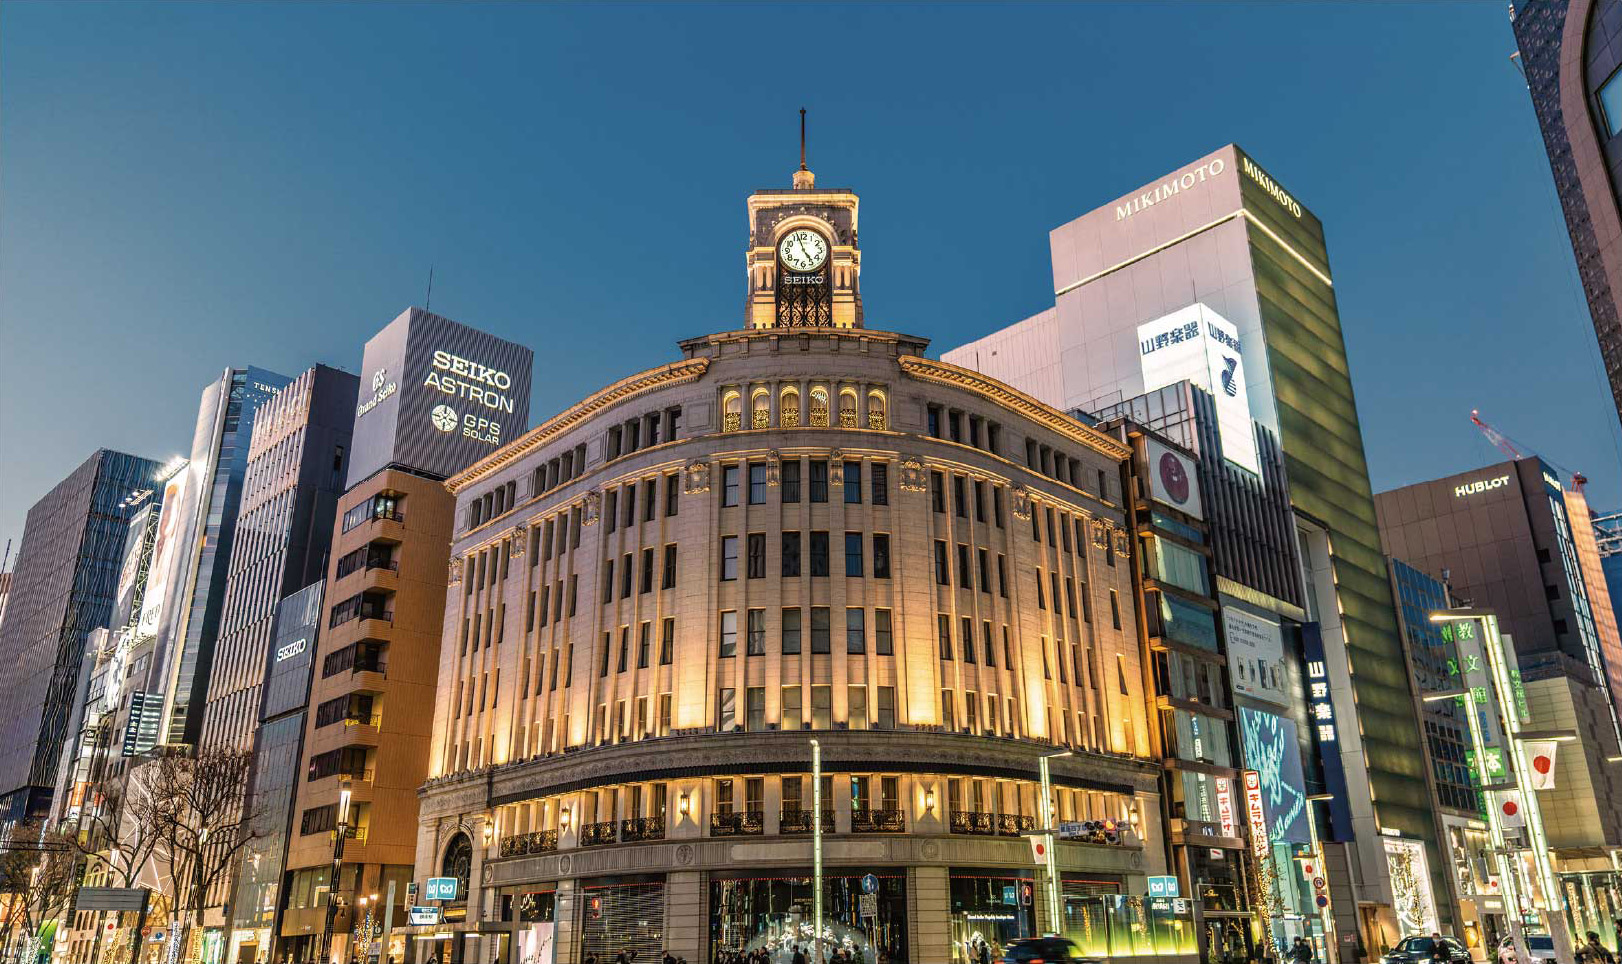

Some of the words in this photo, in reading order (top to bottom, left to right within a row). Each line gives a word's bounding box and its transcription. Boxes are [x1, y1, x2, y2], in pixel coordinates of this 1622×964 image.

[1116, 158, 1225, 221] MIKIMOTO
[1243, 157, 1301, 218] MIKIMOTO
[784, 276, 824, 284] SEIKO
[1141, 321, 1200, 355] 山野楽器
[432, 350, 511, 390] SEIKO
[358, 394, 378, 417] Grand
[378, 382, 397, 402] Seiko
[424, 372, 513, 414] ASTRON
[463, 414, 501, 435] GPS
[463, 427, 499, 446] SOLAR
[1455, 475, 1510, 497] HUBLOT
[277, 638, 307, 663] SEIKO
[1308, 661, 1335, 742] 山野楽器
